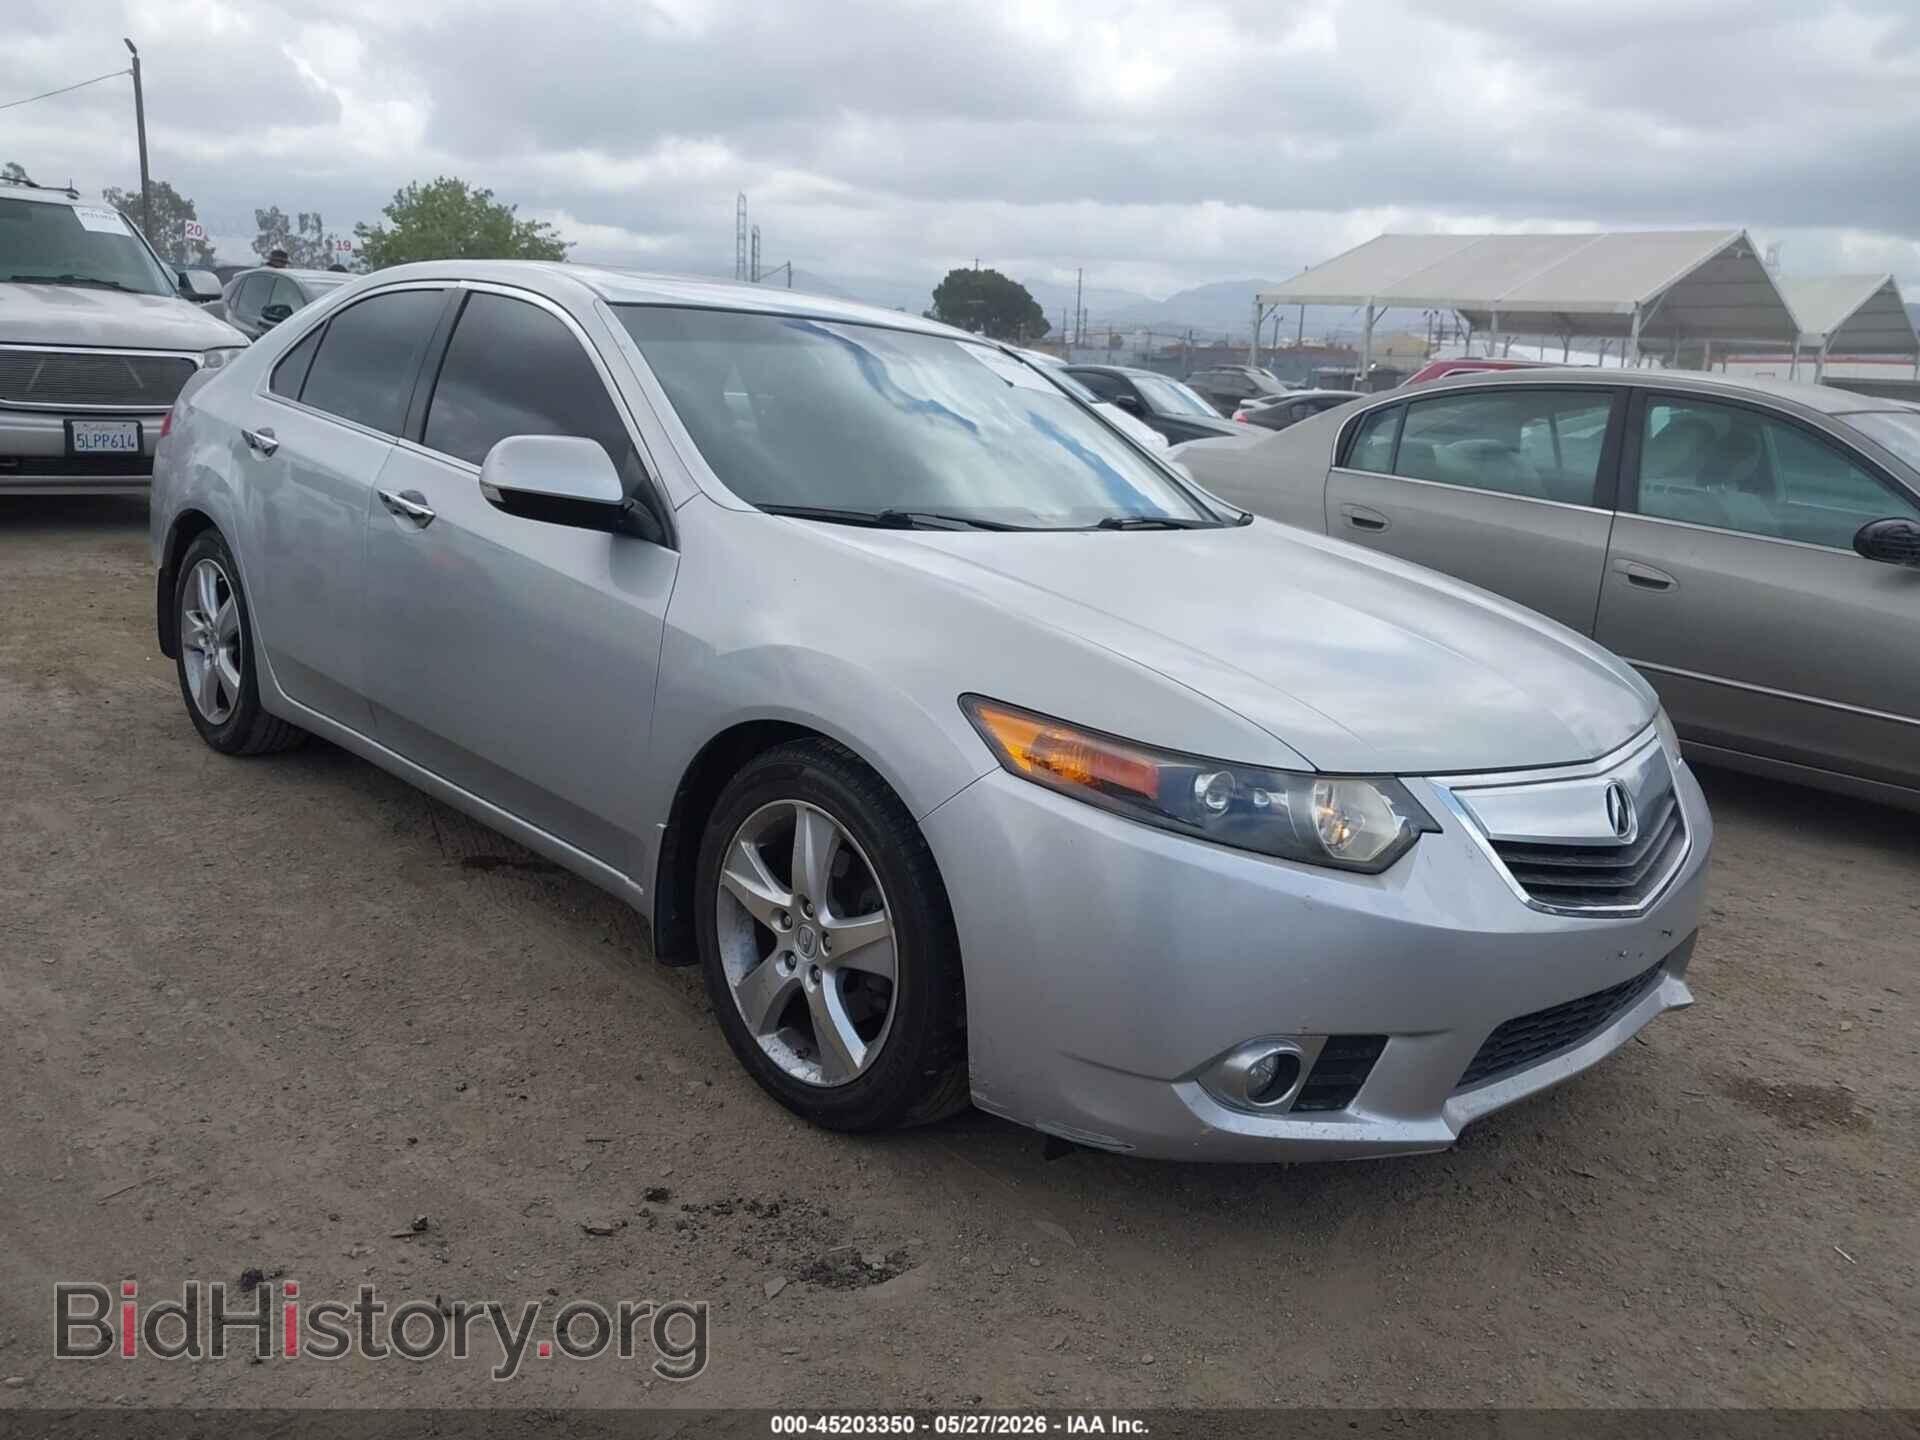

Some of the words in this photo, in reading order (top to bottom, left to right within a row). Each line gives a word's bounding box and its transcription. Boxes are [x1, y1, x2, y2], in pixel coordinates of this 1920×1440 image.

[187, 222, 203, 237] 20
[336, 240, 352, 252] 19
[76, 432, 135, 448] 5LPP614
